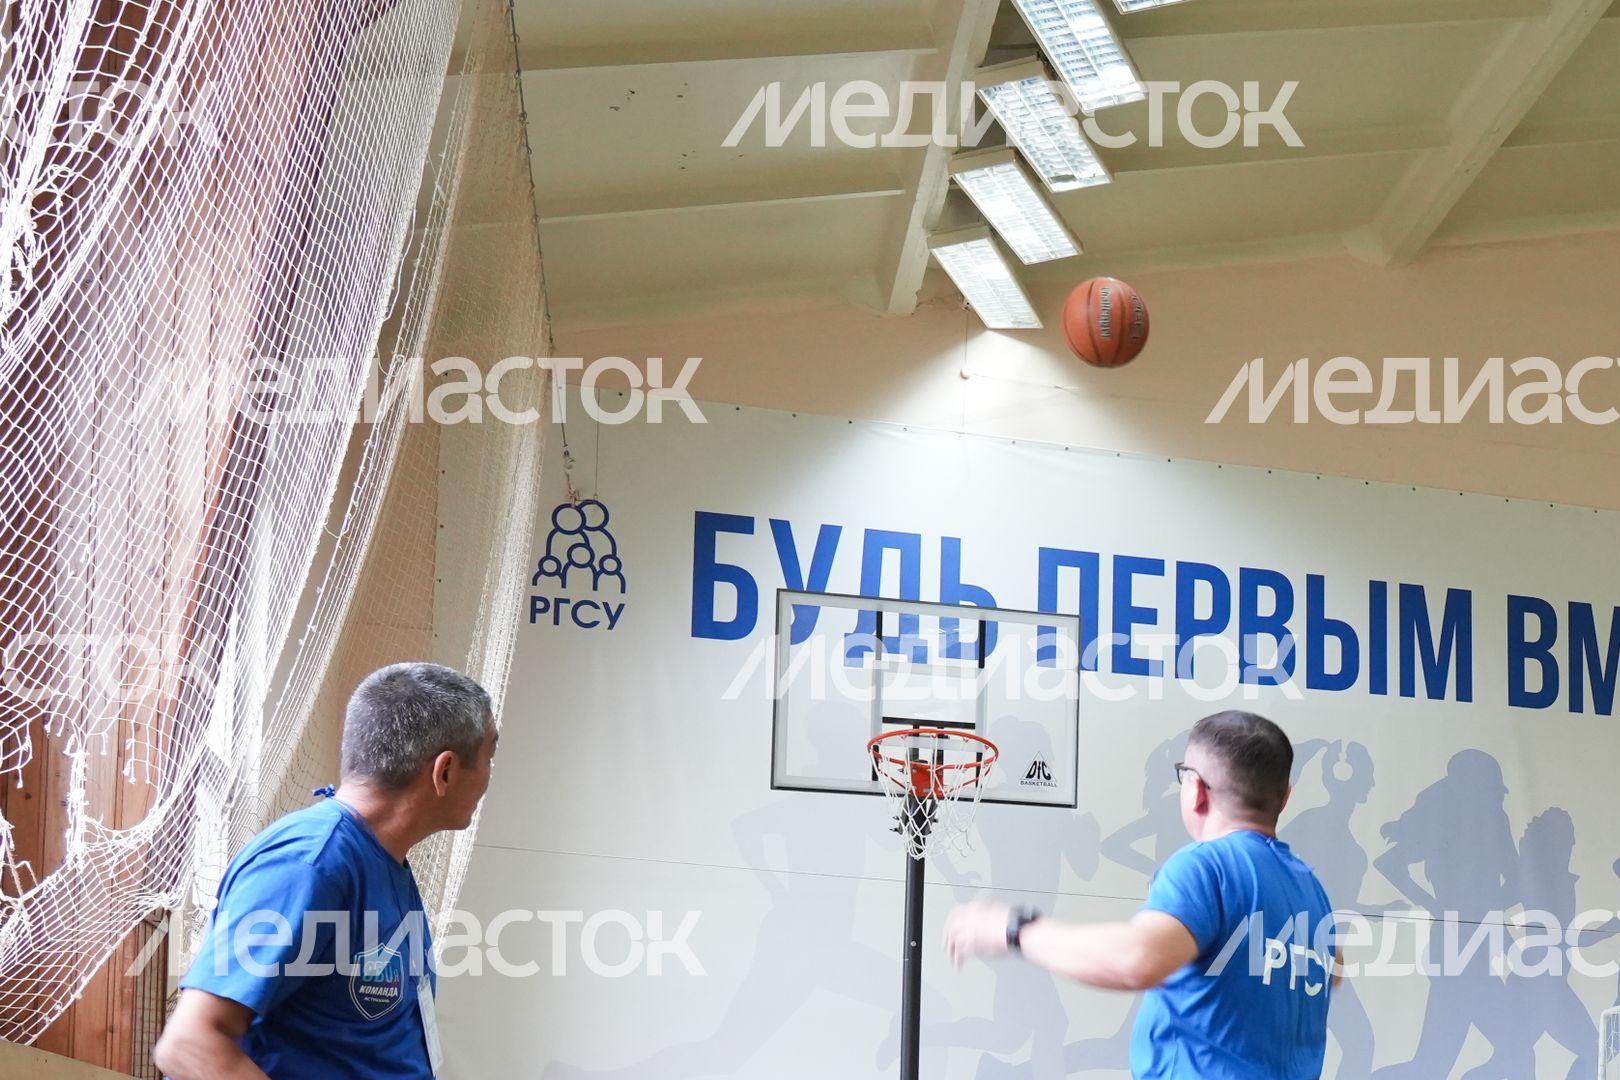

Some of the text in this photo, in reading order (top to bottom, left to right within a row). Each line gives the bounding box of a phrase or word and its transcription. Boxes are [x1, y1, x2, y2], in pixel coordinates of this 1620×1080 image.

[529, 595, 626, 631] РГСУ
[690, 511, 999, 669] БУДЬ
[1037, 546, 1473, 704] ПЕРВЫМ
[1020, 780, 1058, 788] BASKETBALL
[359, 985, 398, 997] КОМАНДА
